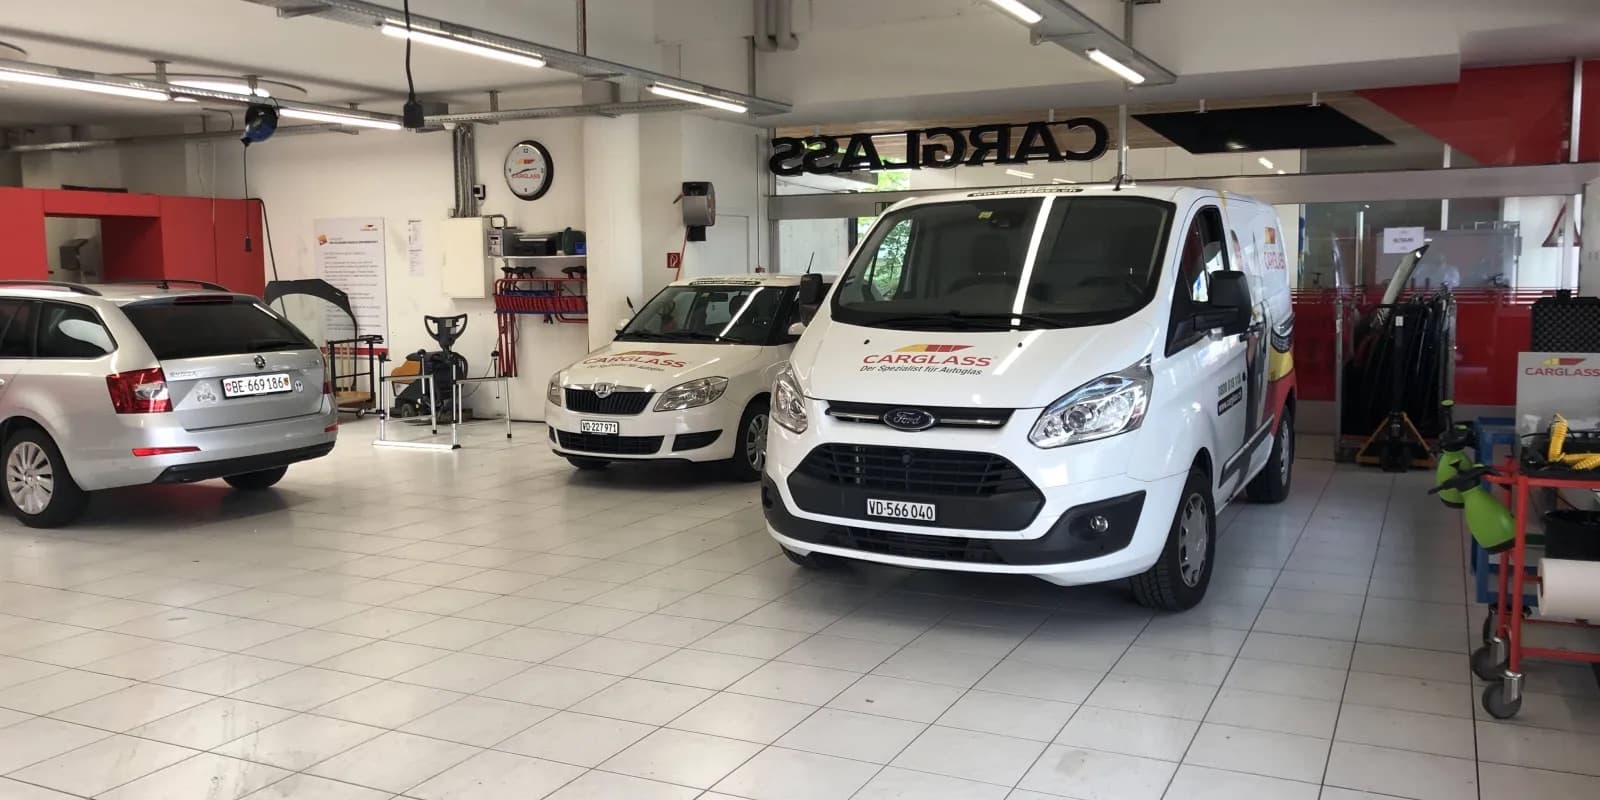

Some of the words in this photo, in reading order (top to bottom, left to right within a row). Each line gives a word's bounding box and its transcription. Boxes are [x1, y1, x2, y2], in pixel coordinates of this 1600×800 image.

[583, 356, 687, 368] CARGLASS
[863, 354, 992, 367] CARGLASS
[877, 364, 923, 373] Spezialist
[924, 365, 940, 373] für
[939, 366, 983, 376] Autoglas
[1525, 367, 1600, 377] CARGLASS
[893, 411, 921, 425] Ford
